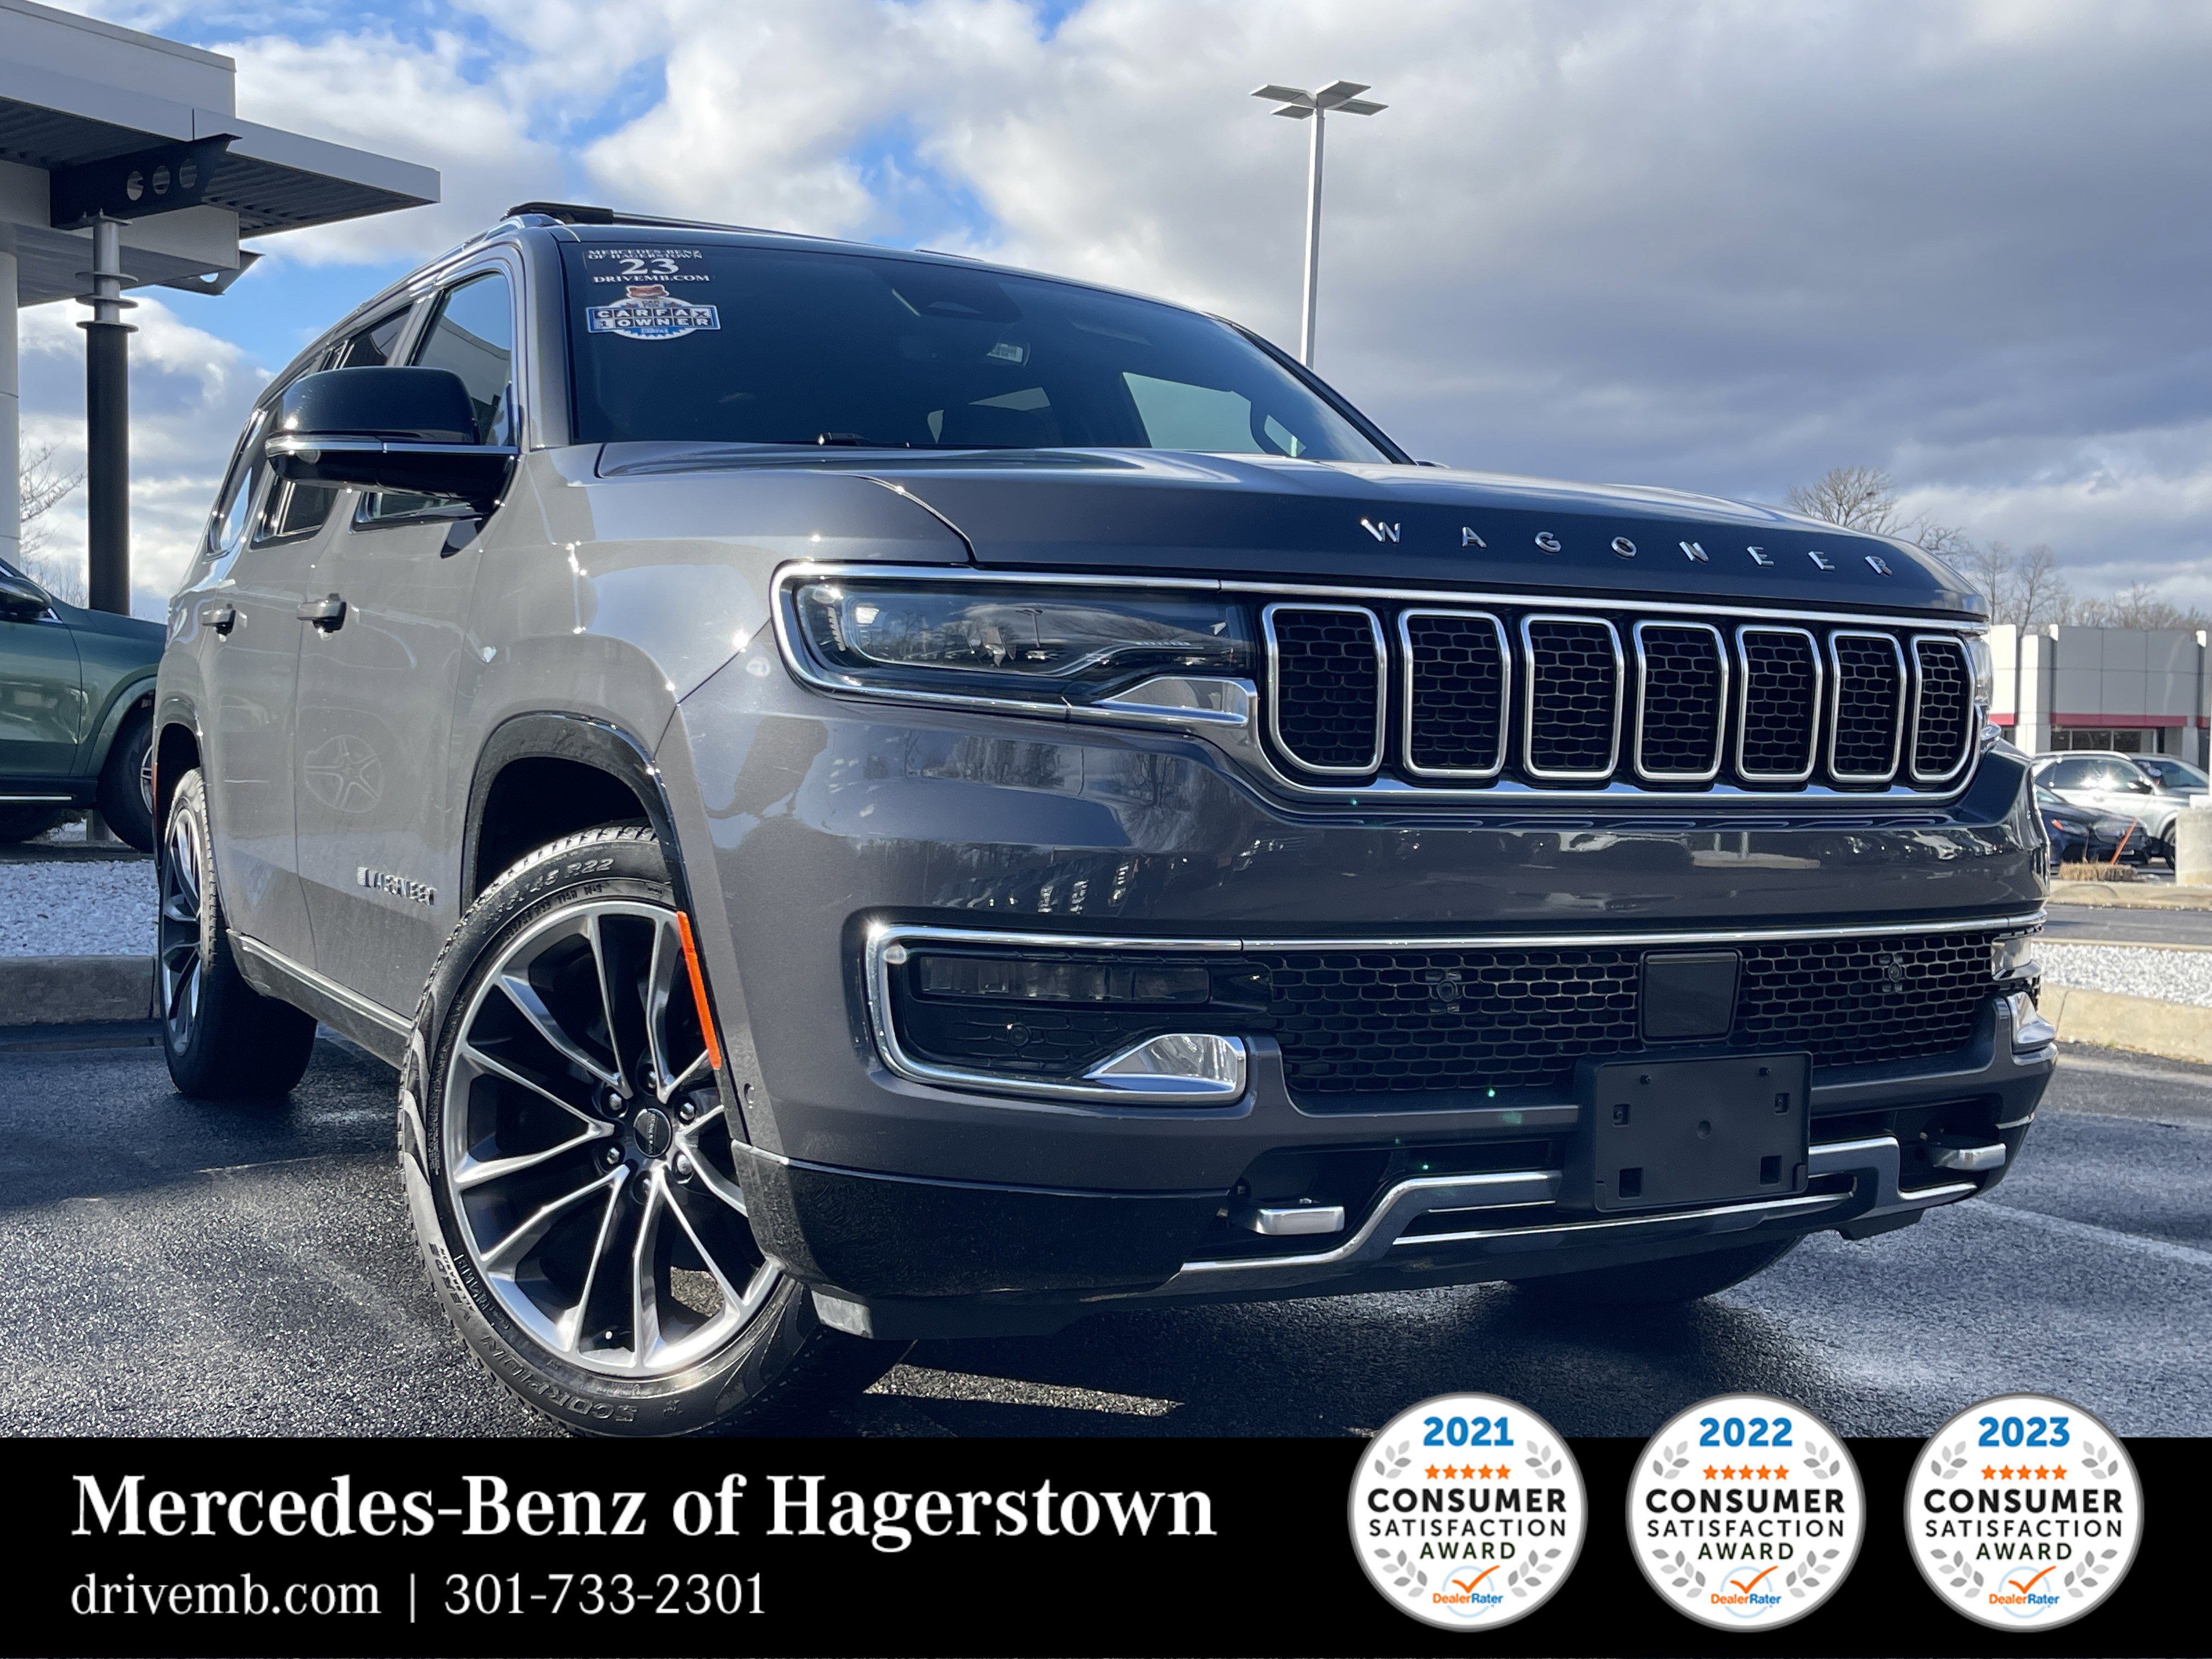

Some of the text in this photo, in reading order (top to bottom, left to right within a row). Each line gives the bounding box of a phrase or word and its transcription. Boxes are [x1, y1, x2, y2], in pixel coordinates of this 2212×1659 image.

[619, 258, 679, 274] 23
[593, 274, 710, 283] DRIVEMB.COM
[597, 309, 711, 319] CARFAX
[1361, 519, 1892, 576] WAGONEER
[565, 858, 614, 879] R22
[479, 1335, 637, 1422] SCORPION
